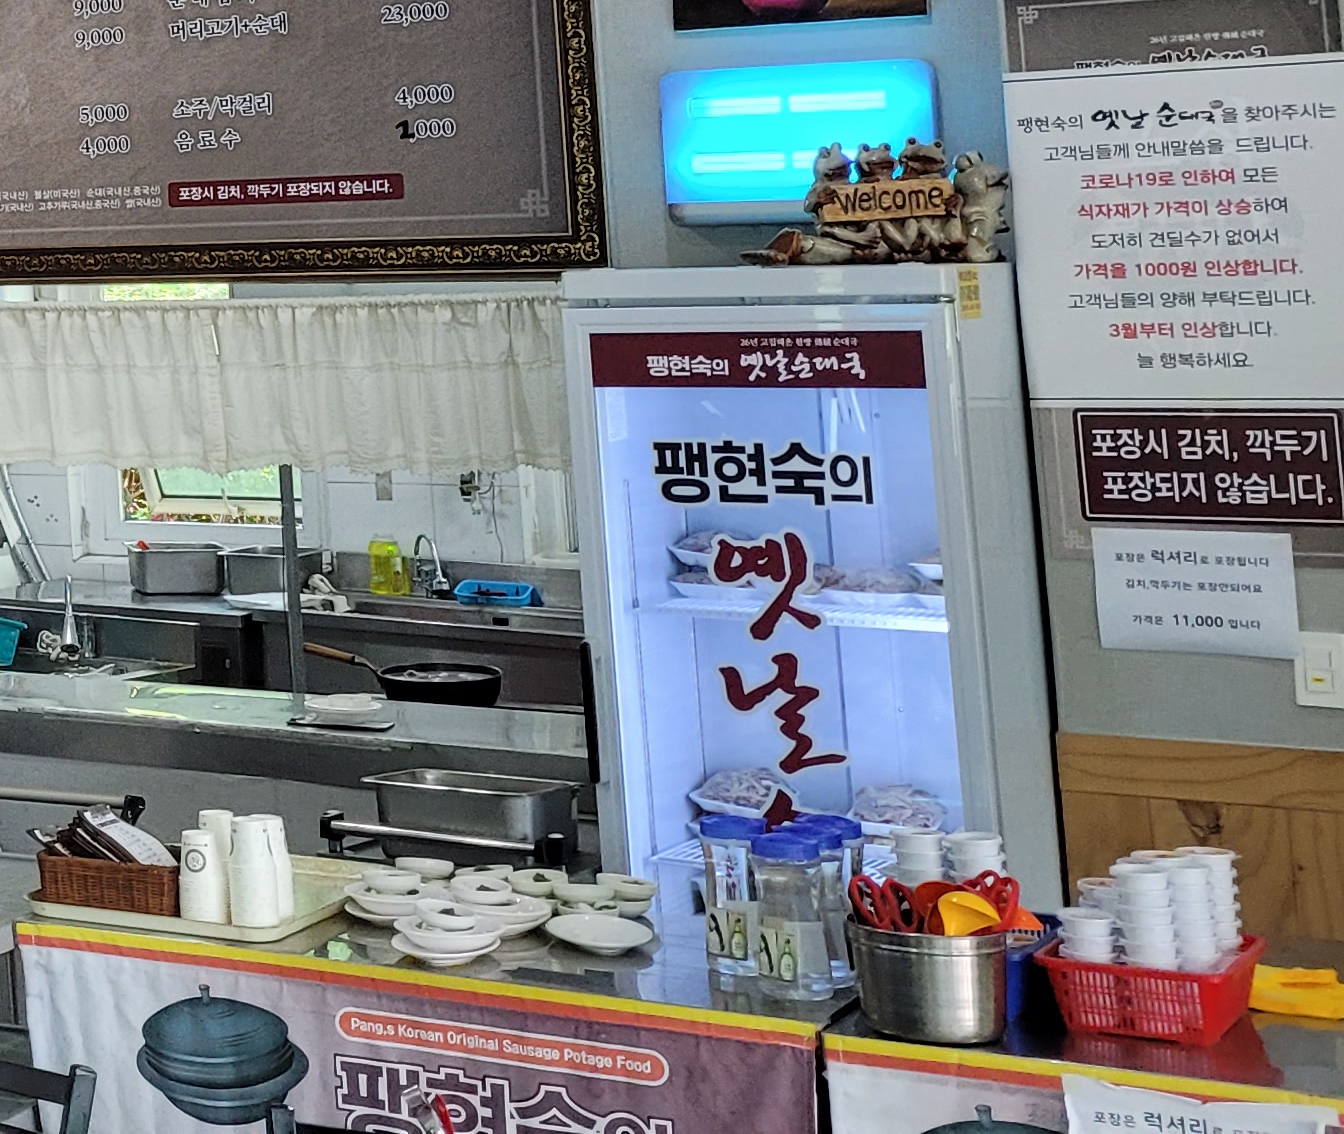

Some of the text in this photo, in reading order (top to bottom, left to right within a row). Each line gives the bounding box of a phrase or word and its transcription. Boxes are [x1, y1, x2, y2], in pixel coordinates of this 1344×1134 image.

[381, 2, 449, 26] 23,000
[75, 28, 124, 50] 9,000
[168, 12, 289, 42] 머리고기+순대
[172, 93, 273, 121] 소주/막걸리
[395, 84, 454, 109] 4,000
[79, 104, 128, 127] 5,000
[1017, 115, 1083, 134] 팽현숙의
[1244, 102, 1337, 122] 찾아주시는
[80, 136, 130, 158] 4,000
[1043, 135, 1313, 162] 고객님들께 안내말씀을 드립니다.
[178, 179, 393, 200] 포장시 김치, 깍두기 포장되지 않습니다.
[1080, 166, 1279, 190] 코로나19로 인하여 모든
[834, 185, 945, 215] Welcome
[1077, 197, 1288, 221] 식자재가 가격이 상승하여
[1091, 228, 1279, 249] 도저히 견딜수가 없어서
[1074, 259, 1303, 279] 가격을 1000원 인상합니다.
[1068, 289, 1316, 309] 고객님들의 양해 부탁드립니다.
[1109, 321, 1278, 339] 3월부터 인상합니다.
[646, 355, 729, 376] 팽현숙의
[1137, 353, 1153, 368] 늘
[1091, 428, 1328, 462] 포장시 김치, 깍두기
[653, 440, 873, 506] 팽현숙의
[1102, 471, 1334, 506] 포장되지 않습니다.
[351, 1018, 651, 1074] Pang,s Korean Original Sausage Potage Food
[1094, 1111, 1136, 1129] 포장은
